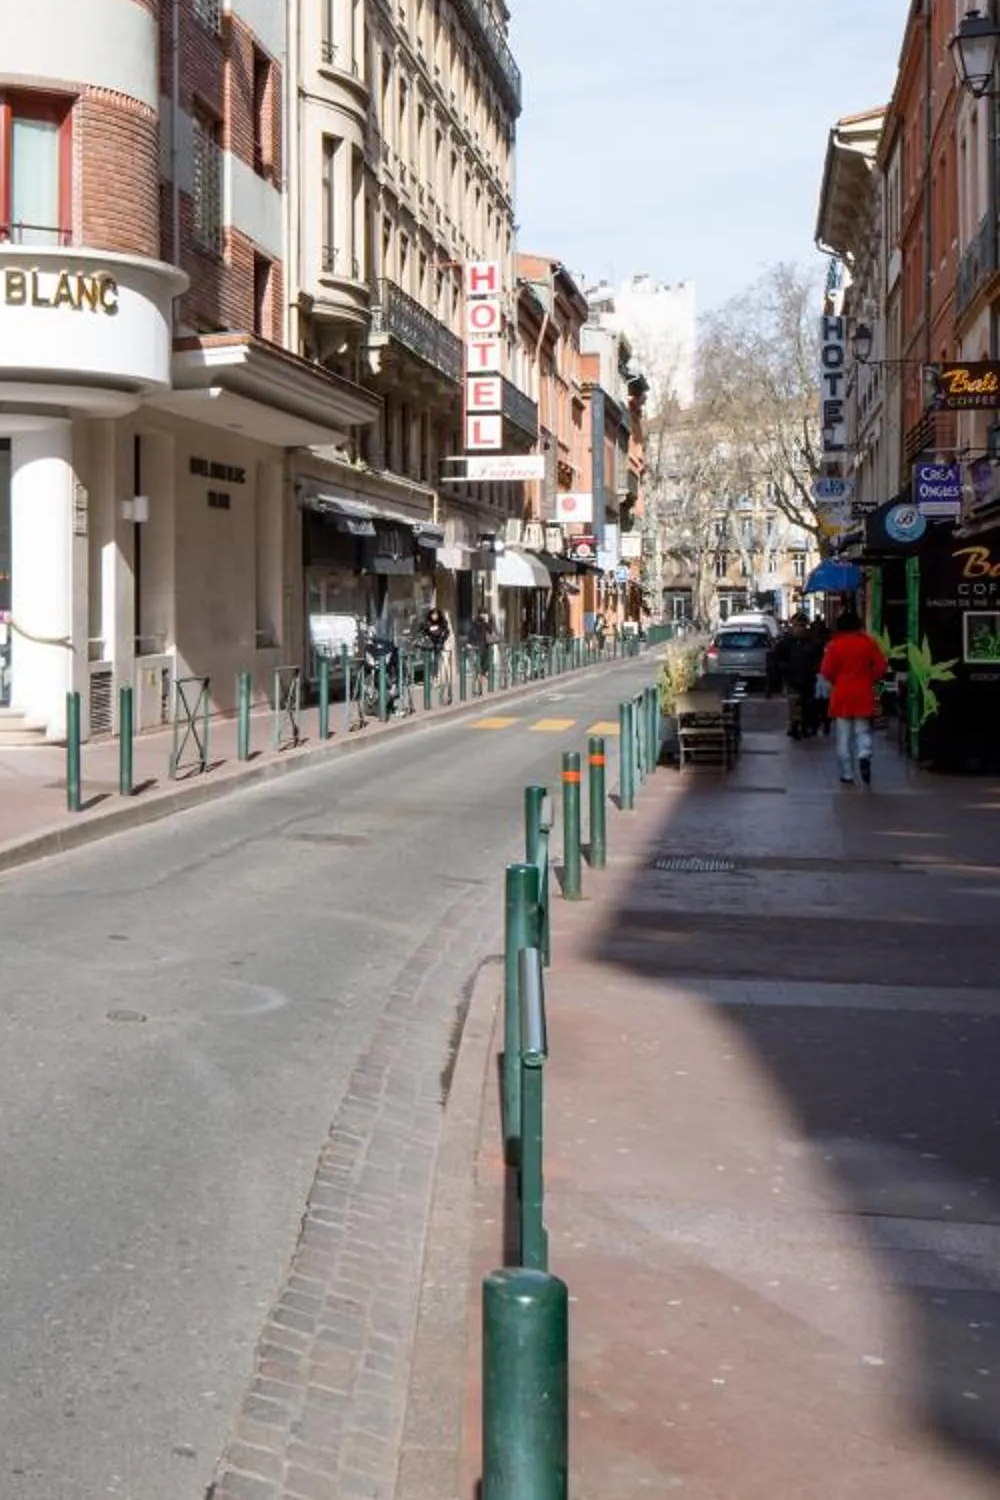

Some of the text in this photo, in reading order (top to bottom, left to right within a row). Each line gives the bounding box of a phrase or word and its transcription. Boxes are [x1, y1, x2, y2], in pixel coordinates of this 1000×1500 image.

[4, 267, 120, 317] BLANC
[470, 265, 497, 445] HOTEL
[822, 316, 844, 452] HOTEL
